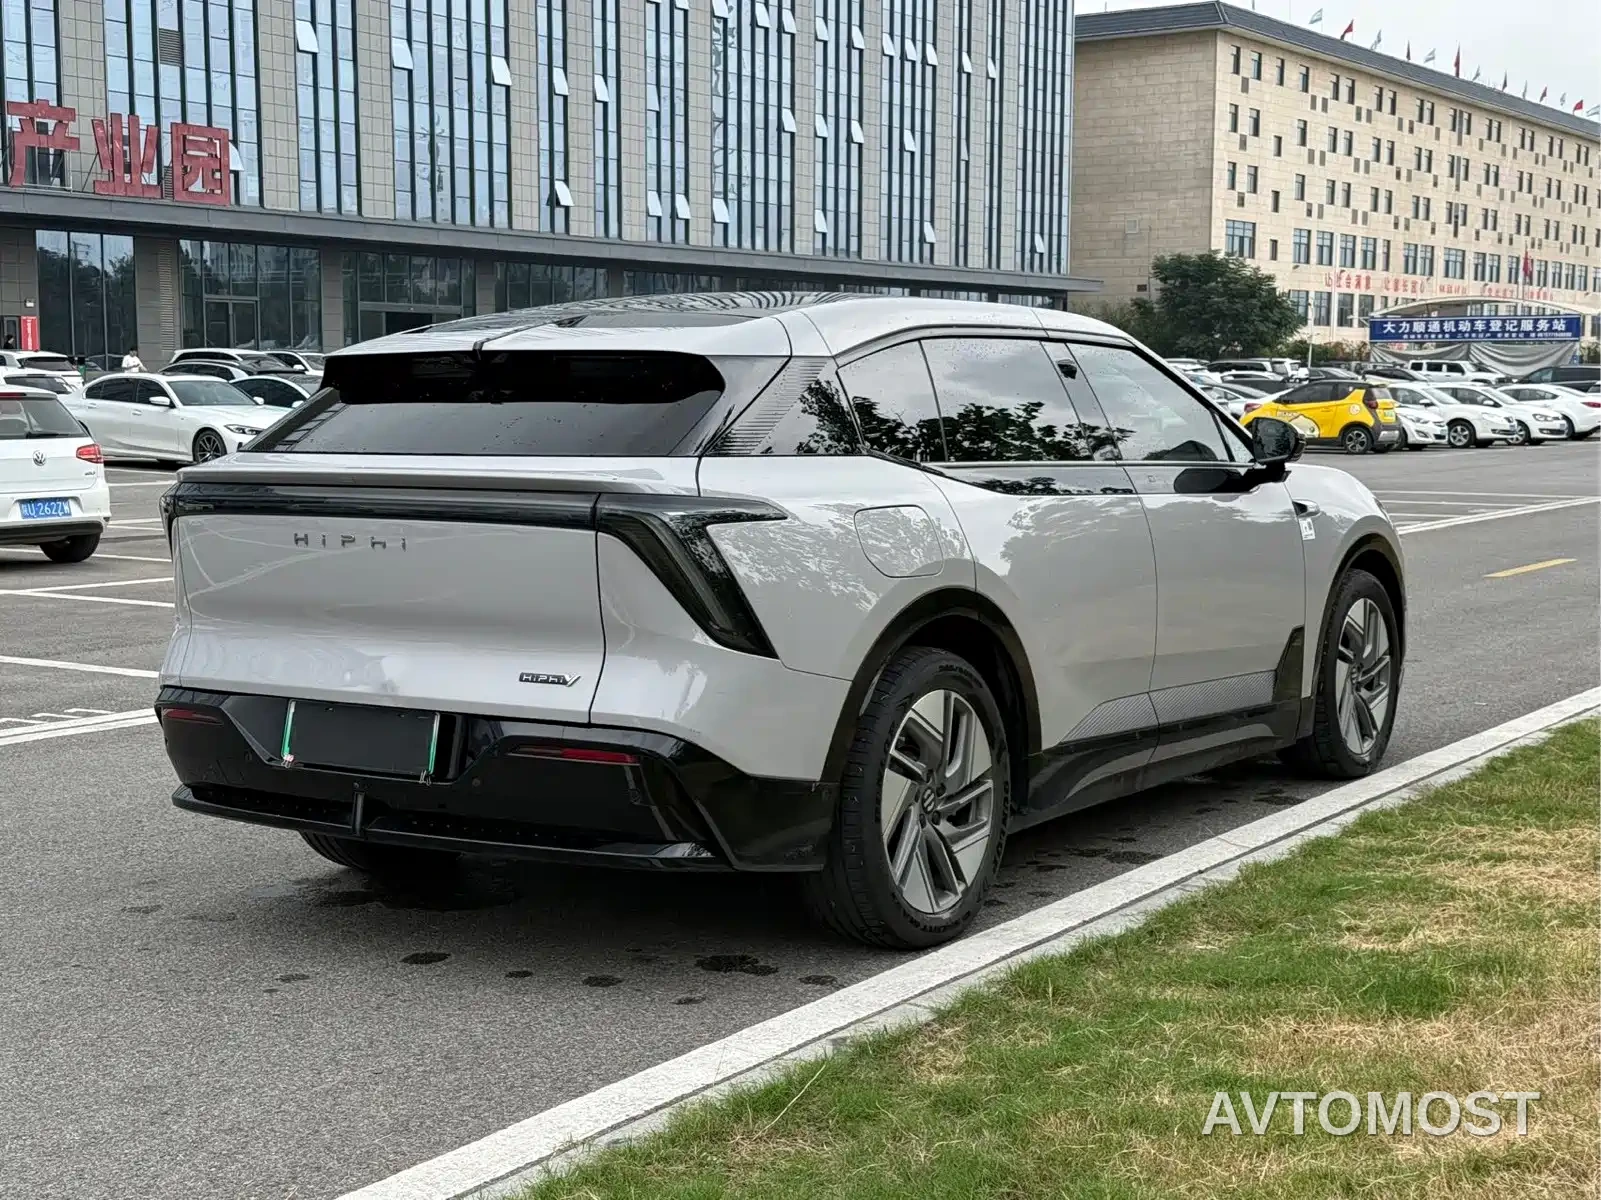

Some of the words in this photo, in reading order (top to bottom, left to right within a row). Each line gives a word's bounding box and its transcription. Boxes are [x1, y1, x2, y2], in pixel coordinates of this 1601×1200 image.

[7, 99, 230, 206] 产业园
[1383, 319, 1566, 333] 大力顺通机动车登记服务站
